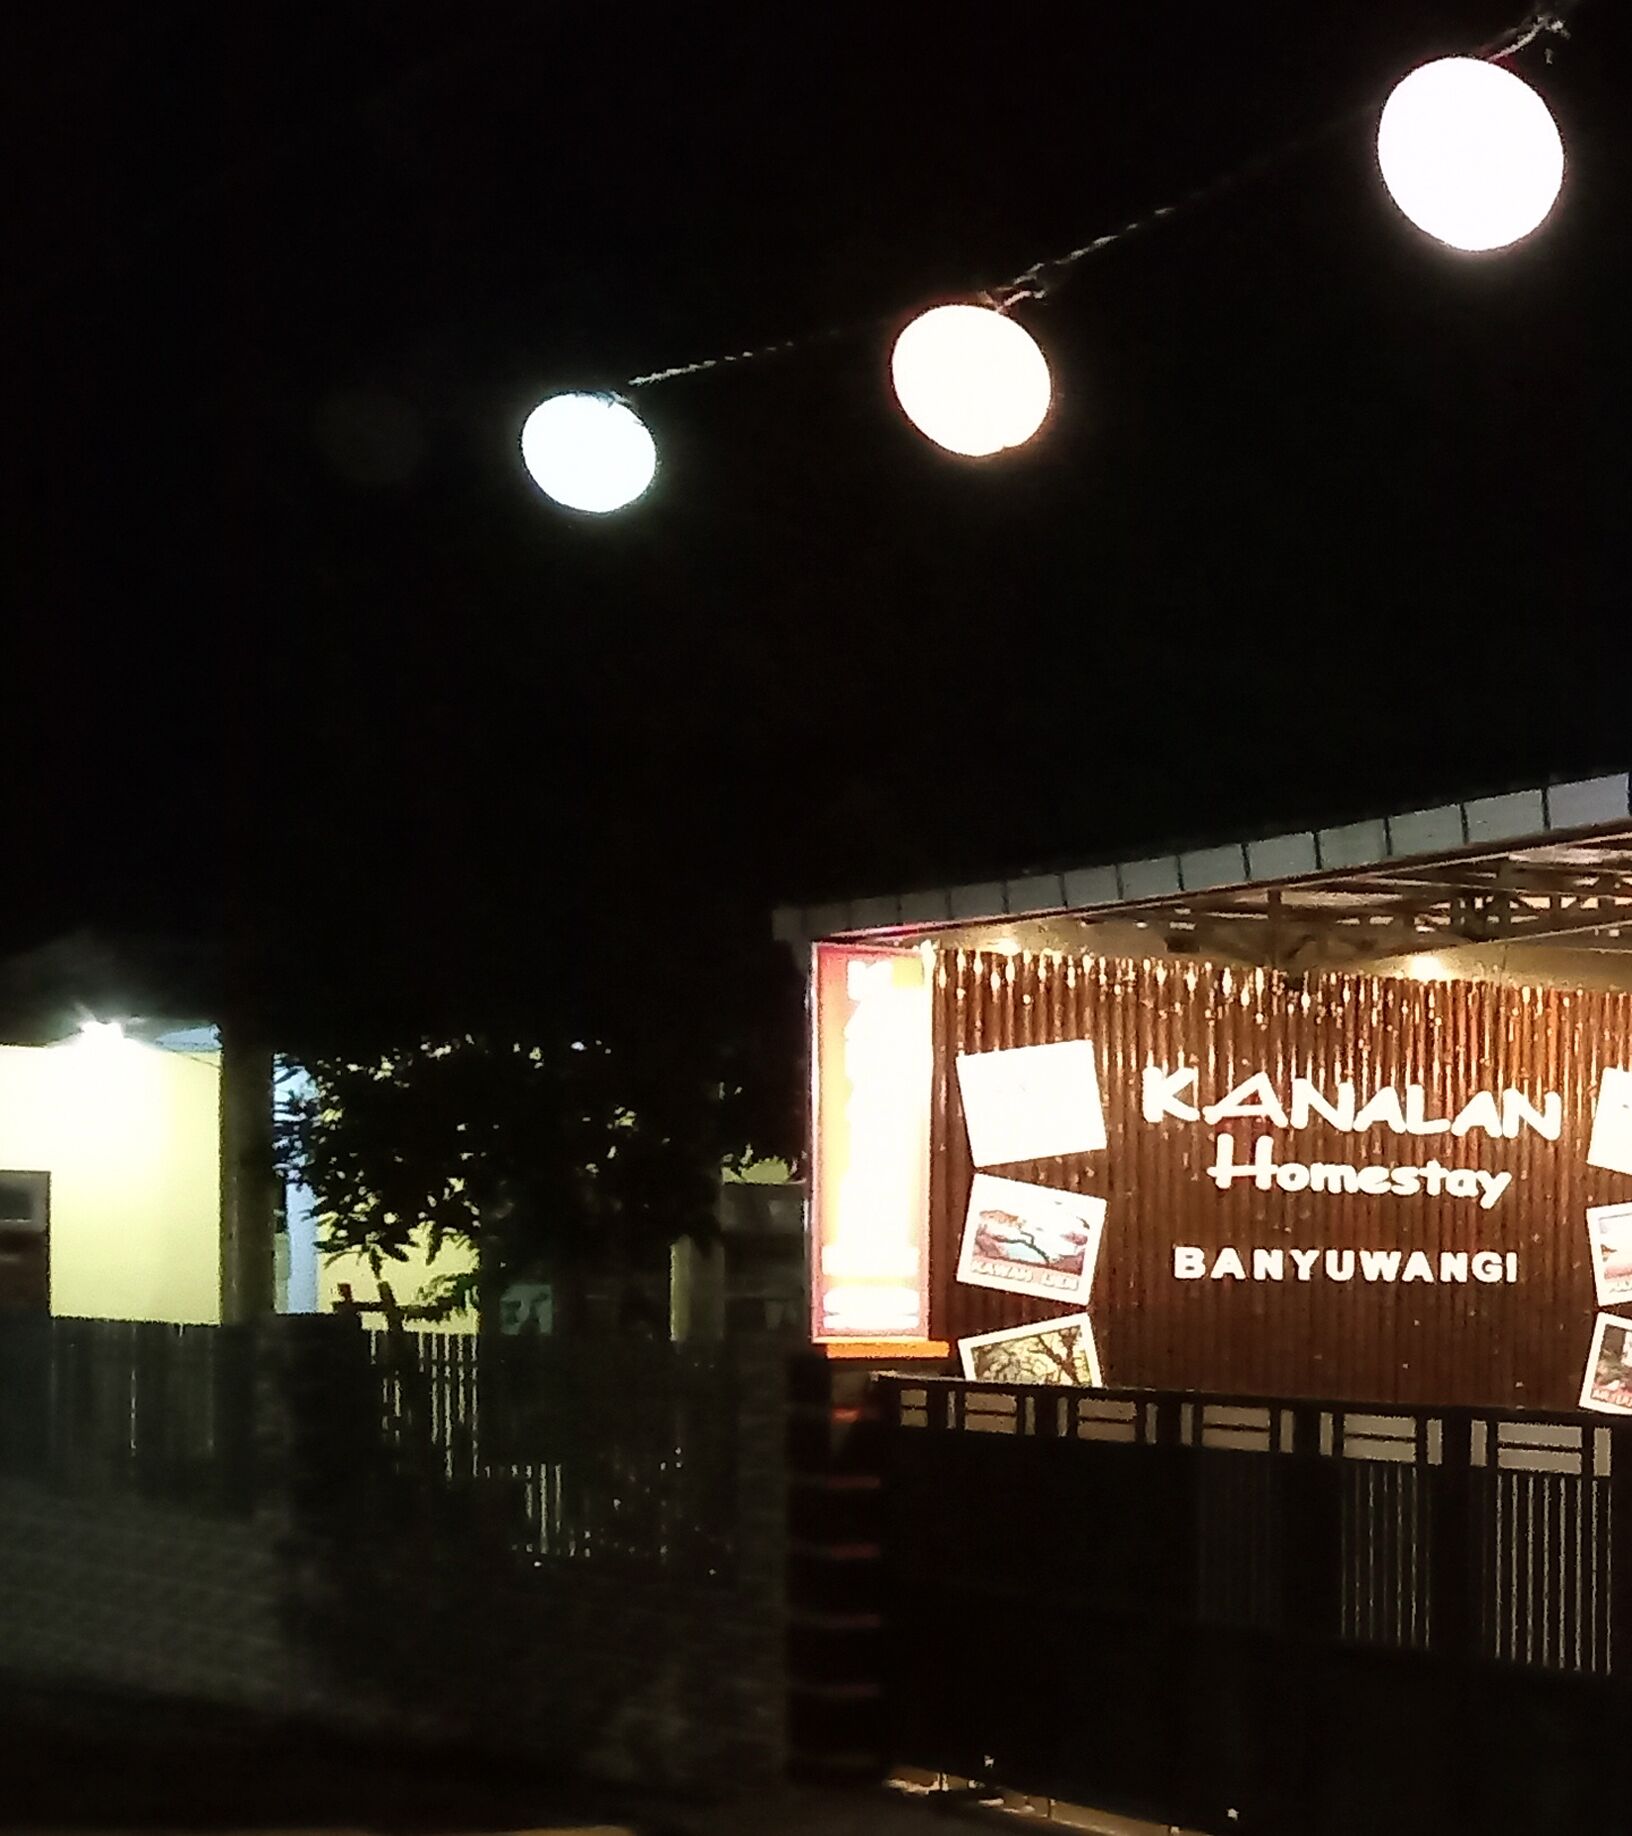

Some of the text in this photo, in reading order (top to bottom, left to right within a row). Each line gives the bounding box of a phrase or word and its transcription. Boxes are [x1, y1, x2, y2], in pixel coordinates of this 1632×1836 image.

[1142, 1066, 1561, 1141] KANALAN
[1207, 1133, 1512, 1209] Homestay
[1173, 1246, 1518, 1283] BANYUWANGI
